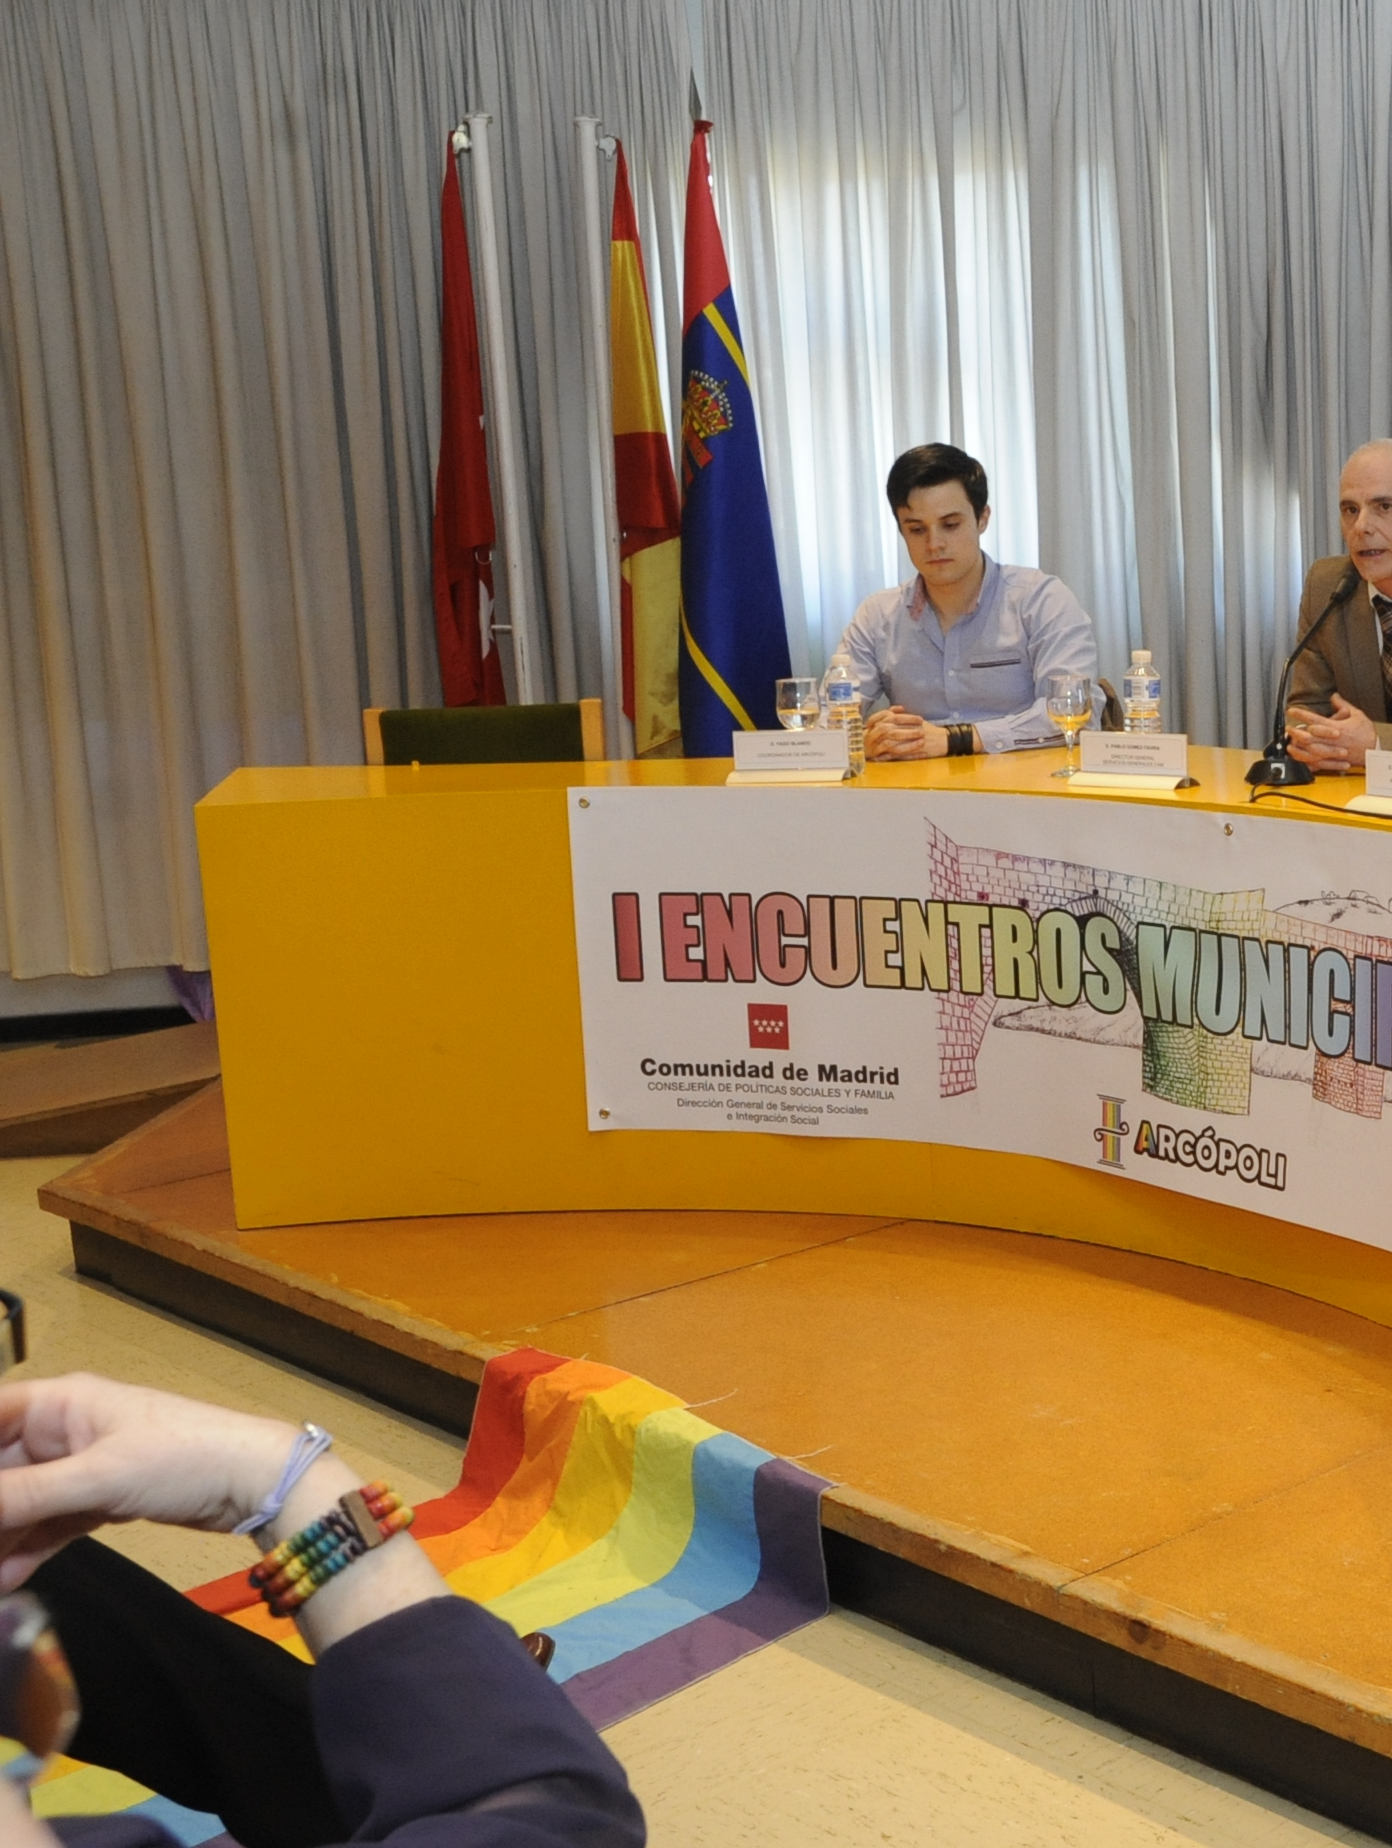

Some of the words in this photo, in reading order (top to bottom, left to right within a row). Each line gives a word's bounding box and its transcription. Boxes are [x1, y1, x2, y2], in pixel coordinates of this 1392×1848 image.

[612, 892, 644, 982] I
[658, 892, 1128, 1015] ENCUENTROS
[640, 1058, 774, 1079] Comunidad
[782, 1062, 809, 1081] de
[817, 1064, 899, 1085] Madrid
[648, 1080, 715, 1092] CONSEJERÍA
[718, 1082, 733, 1092] DE
[735, 1082, 787, 1096] POLÍTICAS
[789, 1085, 841, 1098] SOCIALES
[844, 1088, 851, 1098] Y
[854, 1089, 895, 1100] FAMILIA
[677, 1098, 724, 1108] Dirección
[727, 1099, 764, 1110] General
[766, 1100, 778, 1111] de
[780, 1102, 824, 1113] Servicios
[827, 1103, 869, 1115] Sociales
[735, 1112, 788, 1124] Integración
[790, 1114, 820, 1126] Social
[1134, 1119, 1287, 1192] ARCÓPOLI
